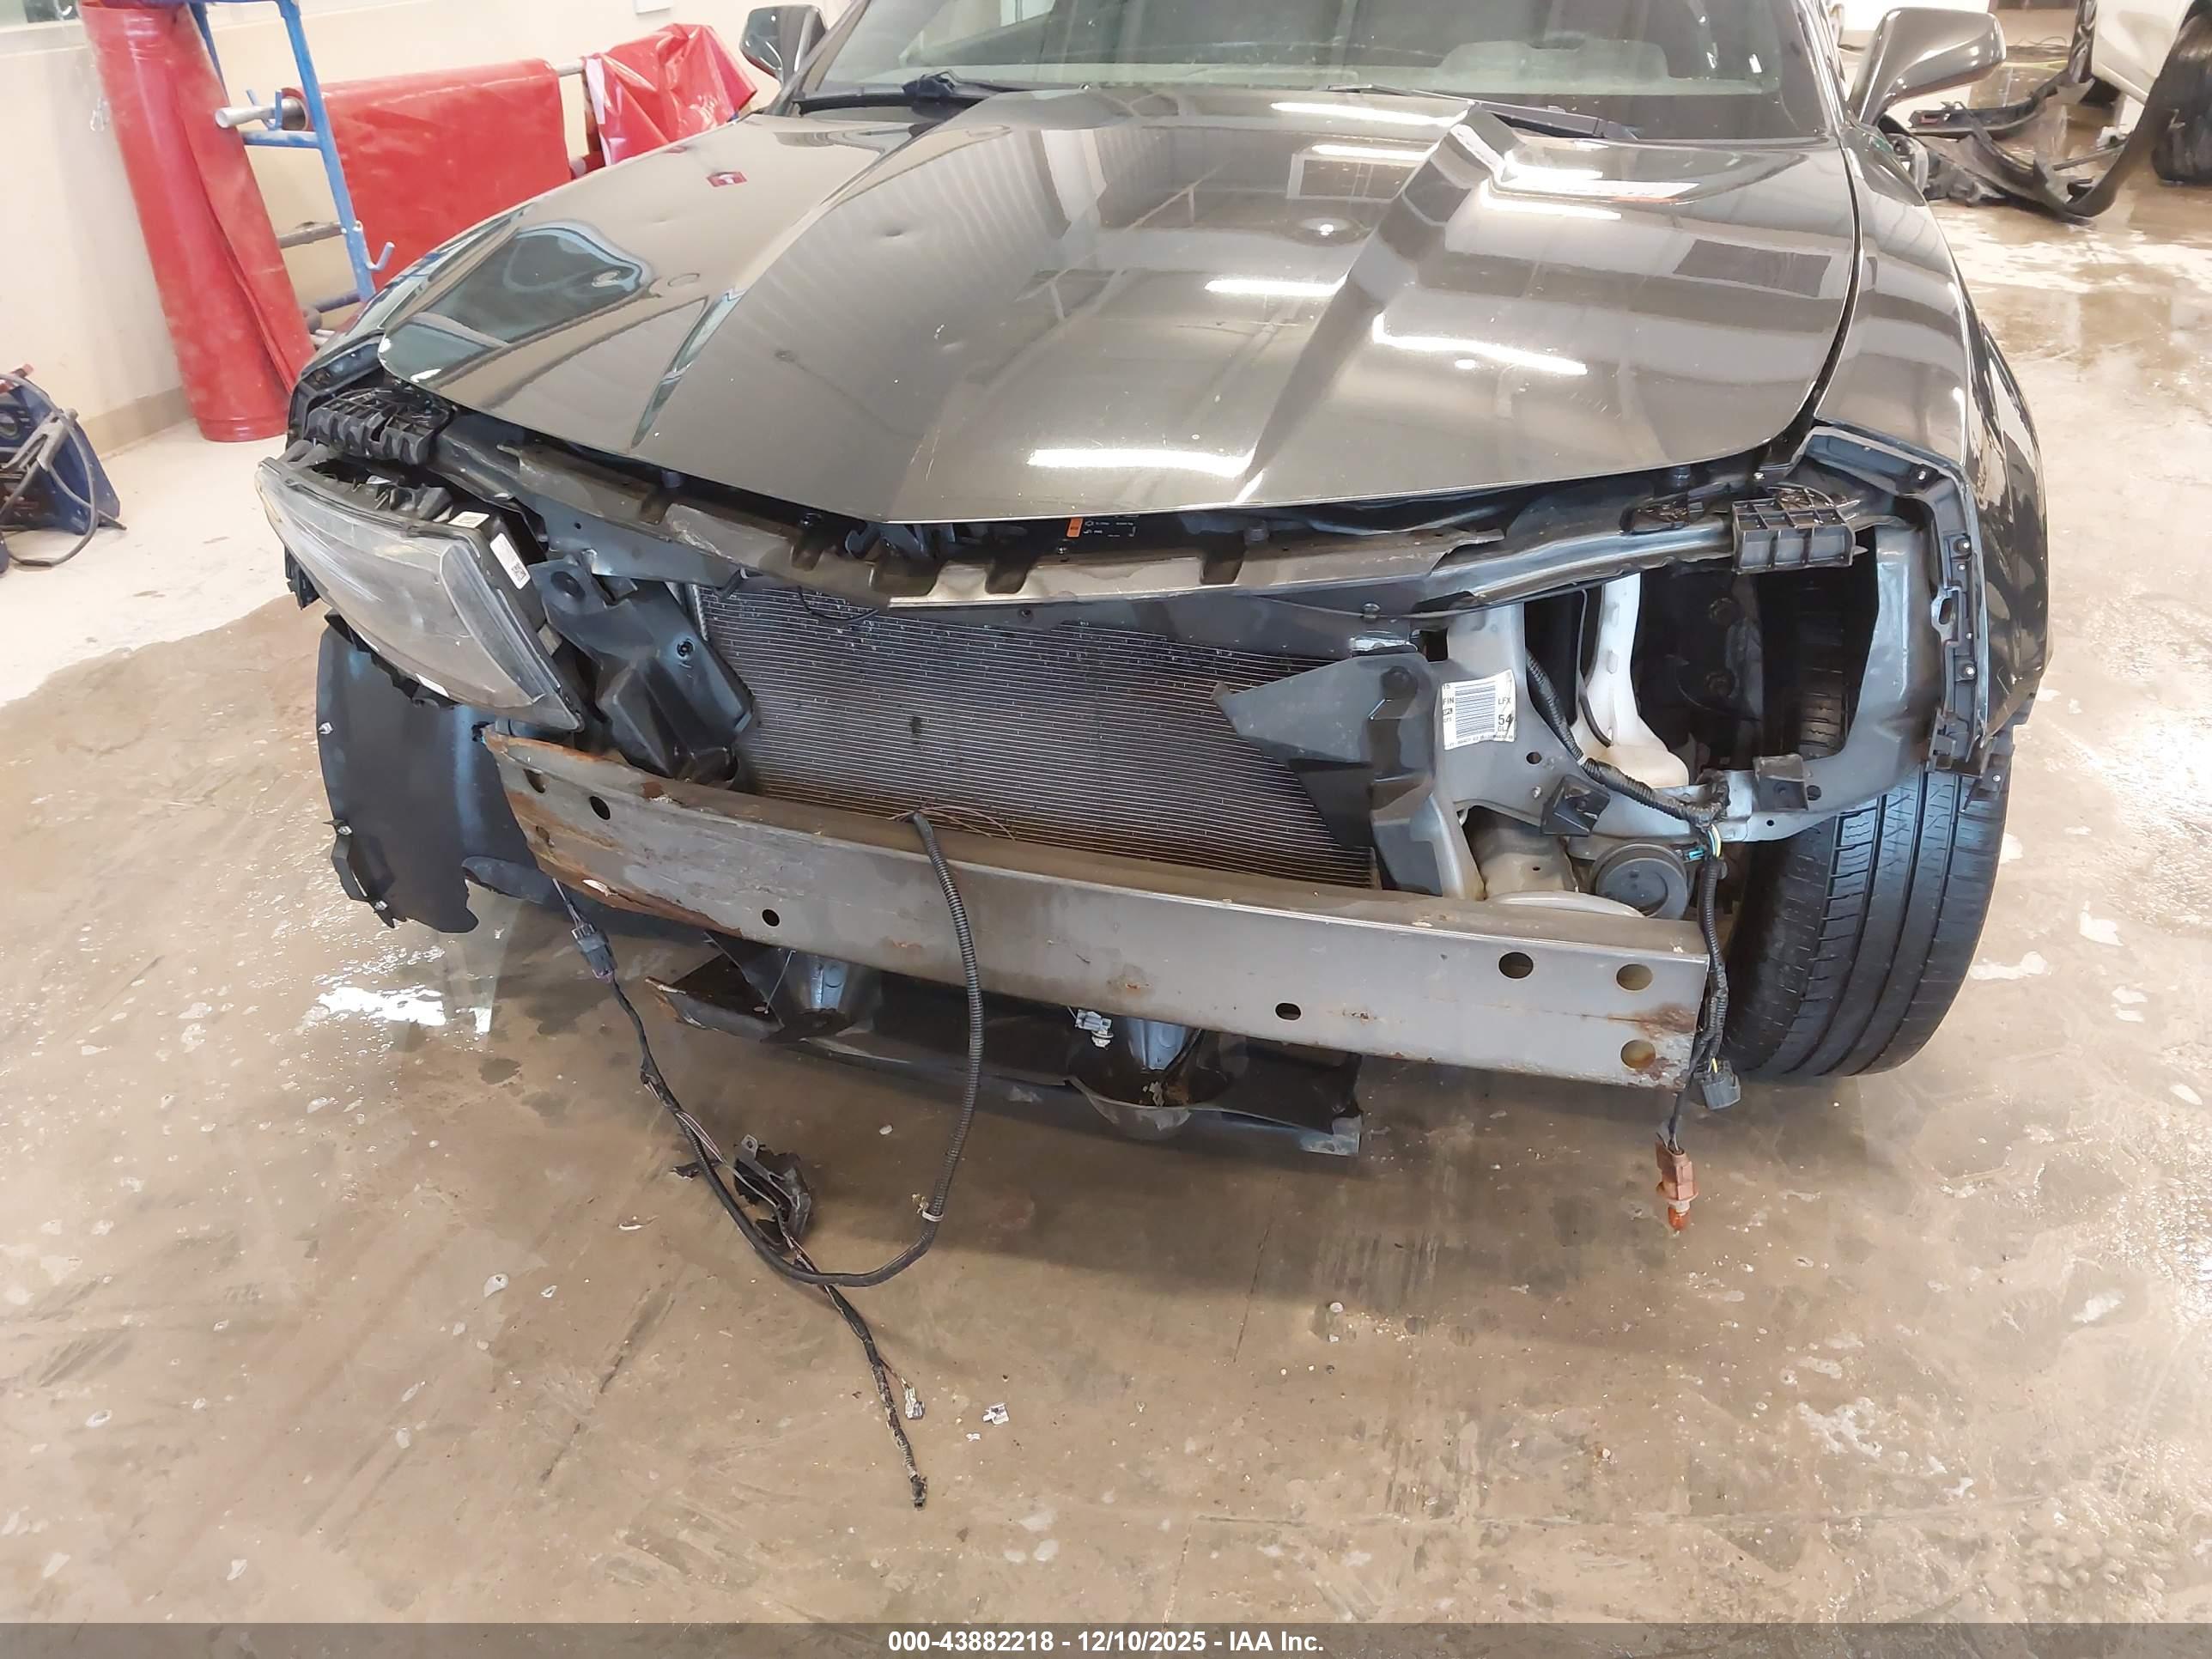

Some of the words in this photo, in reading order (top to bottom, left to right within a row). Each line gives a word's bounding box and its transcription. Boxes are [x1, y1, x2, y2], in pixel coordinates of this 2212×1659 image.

[1443, 696, 1455, 706] FIN
[1498, 696, 1511, 705] LFX
[1498, 714, 1512, 726] 54
